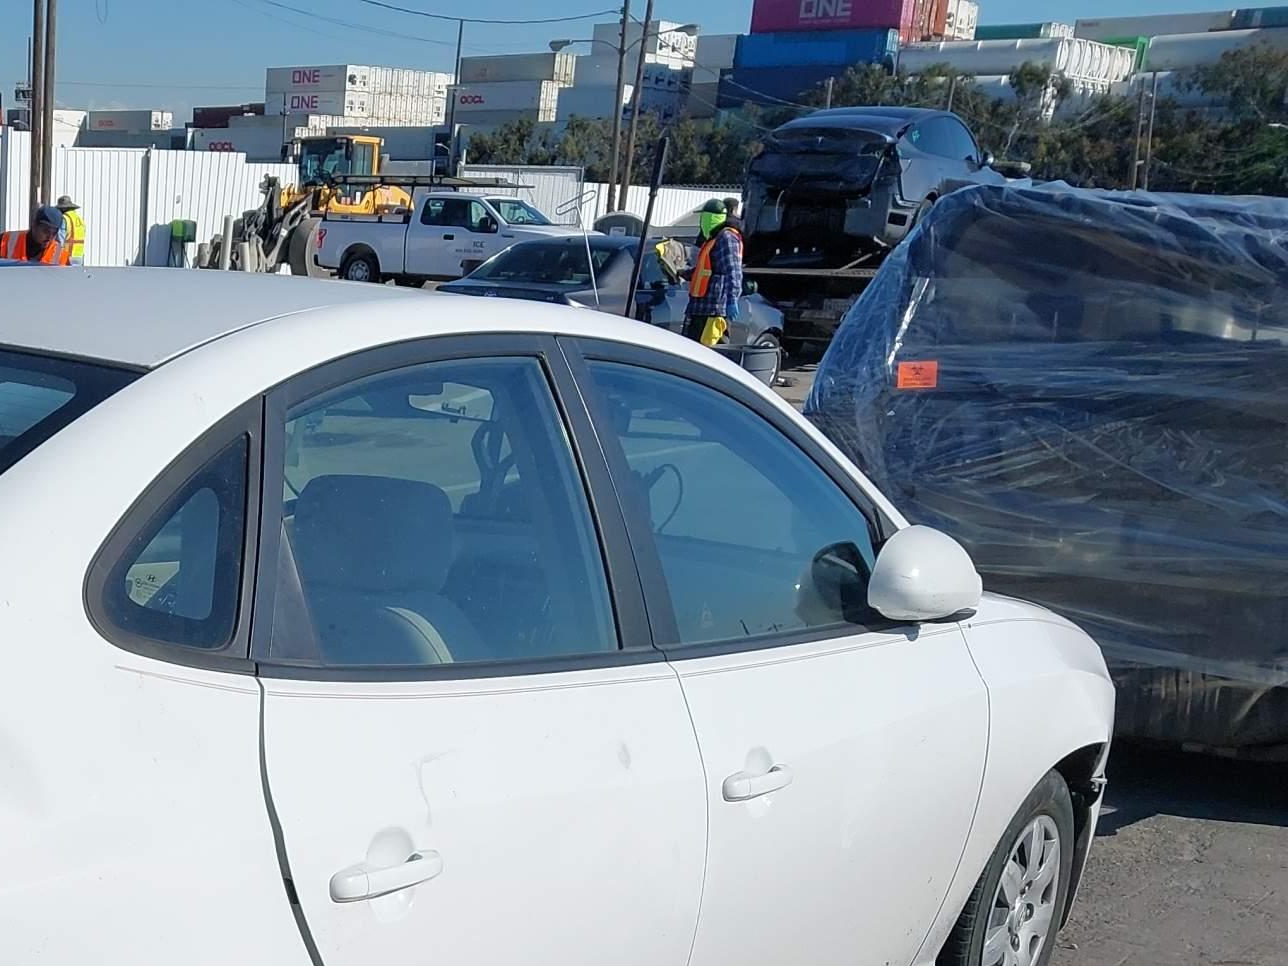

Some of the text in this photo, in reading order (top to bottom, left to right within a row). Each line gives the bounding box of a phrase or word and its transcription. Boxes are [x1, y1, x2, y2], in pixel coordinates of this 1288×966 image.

[799, 0, 852, 18] ONE
[292, 69, 321, 84] ONE
[291, 95, 319, 109] ONE
